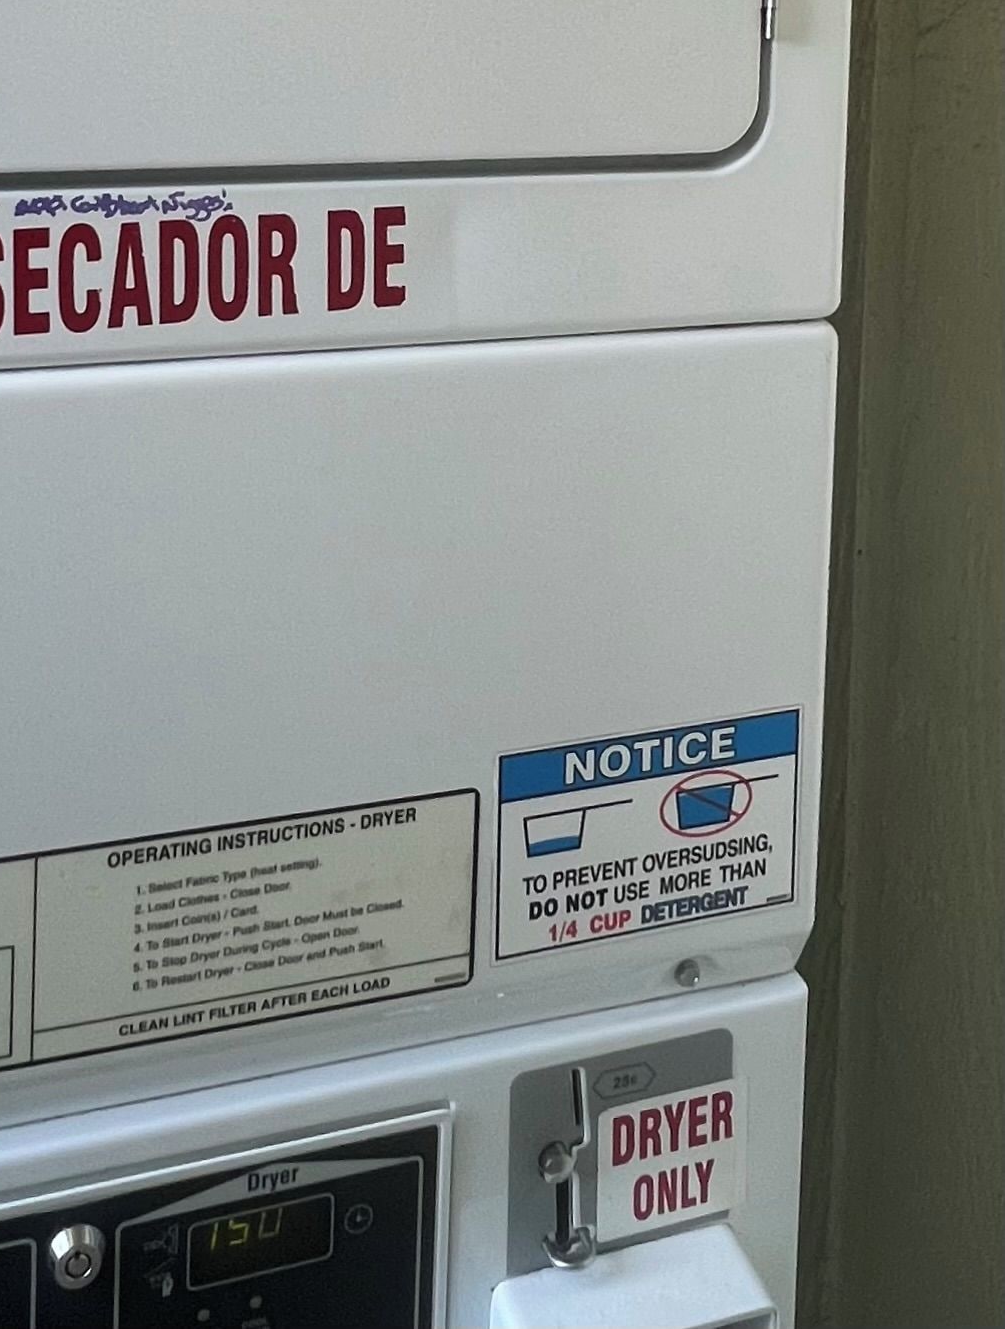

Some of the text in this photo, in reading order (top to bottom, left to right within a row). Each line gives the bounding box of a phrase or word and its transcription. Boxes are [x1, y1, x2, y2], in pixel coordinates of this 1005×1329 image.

[327, 206, 406, 312] DE
[565, 727, 736, 784] NOTICE
[107, 807, 417, 868] OPERATING INSTRUCTIONS DRYER
[522, 833, 772, 895] TO PREVENT OVERSUDSING,
[529, 859, 767, 920] DO NOT USE MORE THAN
[549, 886, 748, 942] 1/4 CUP DETERGENT
[118, 977, 391, 1037] CLEAN LINT FILTER AFTER EACH LOAD
[612, 1091, 733, 1166] DRYER
[247, 1168, 300, 1192] Dryer
[633, 1159, 714, 1221] ONLY
